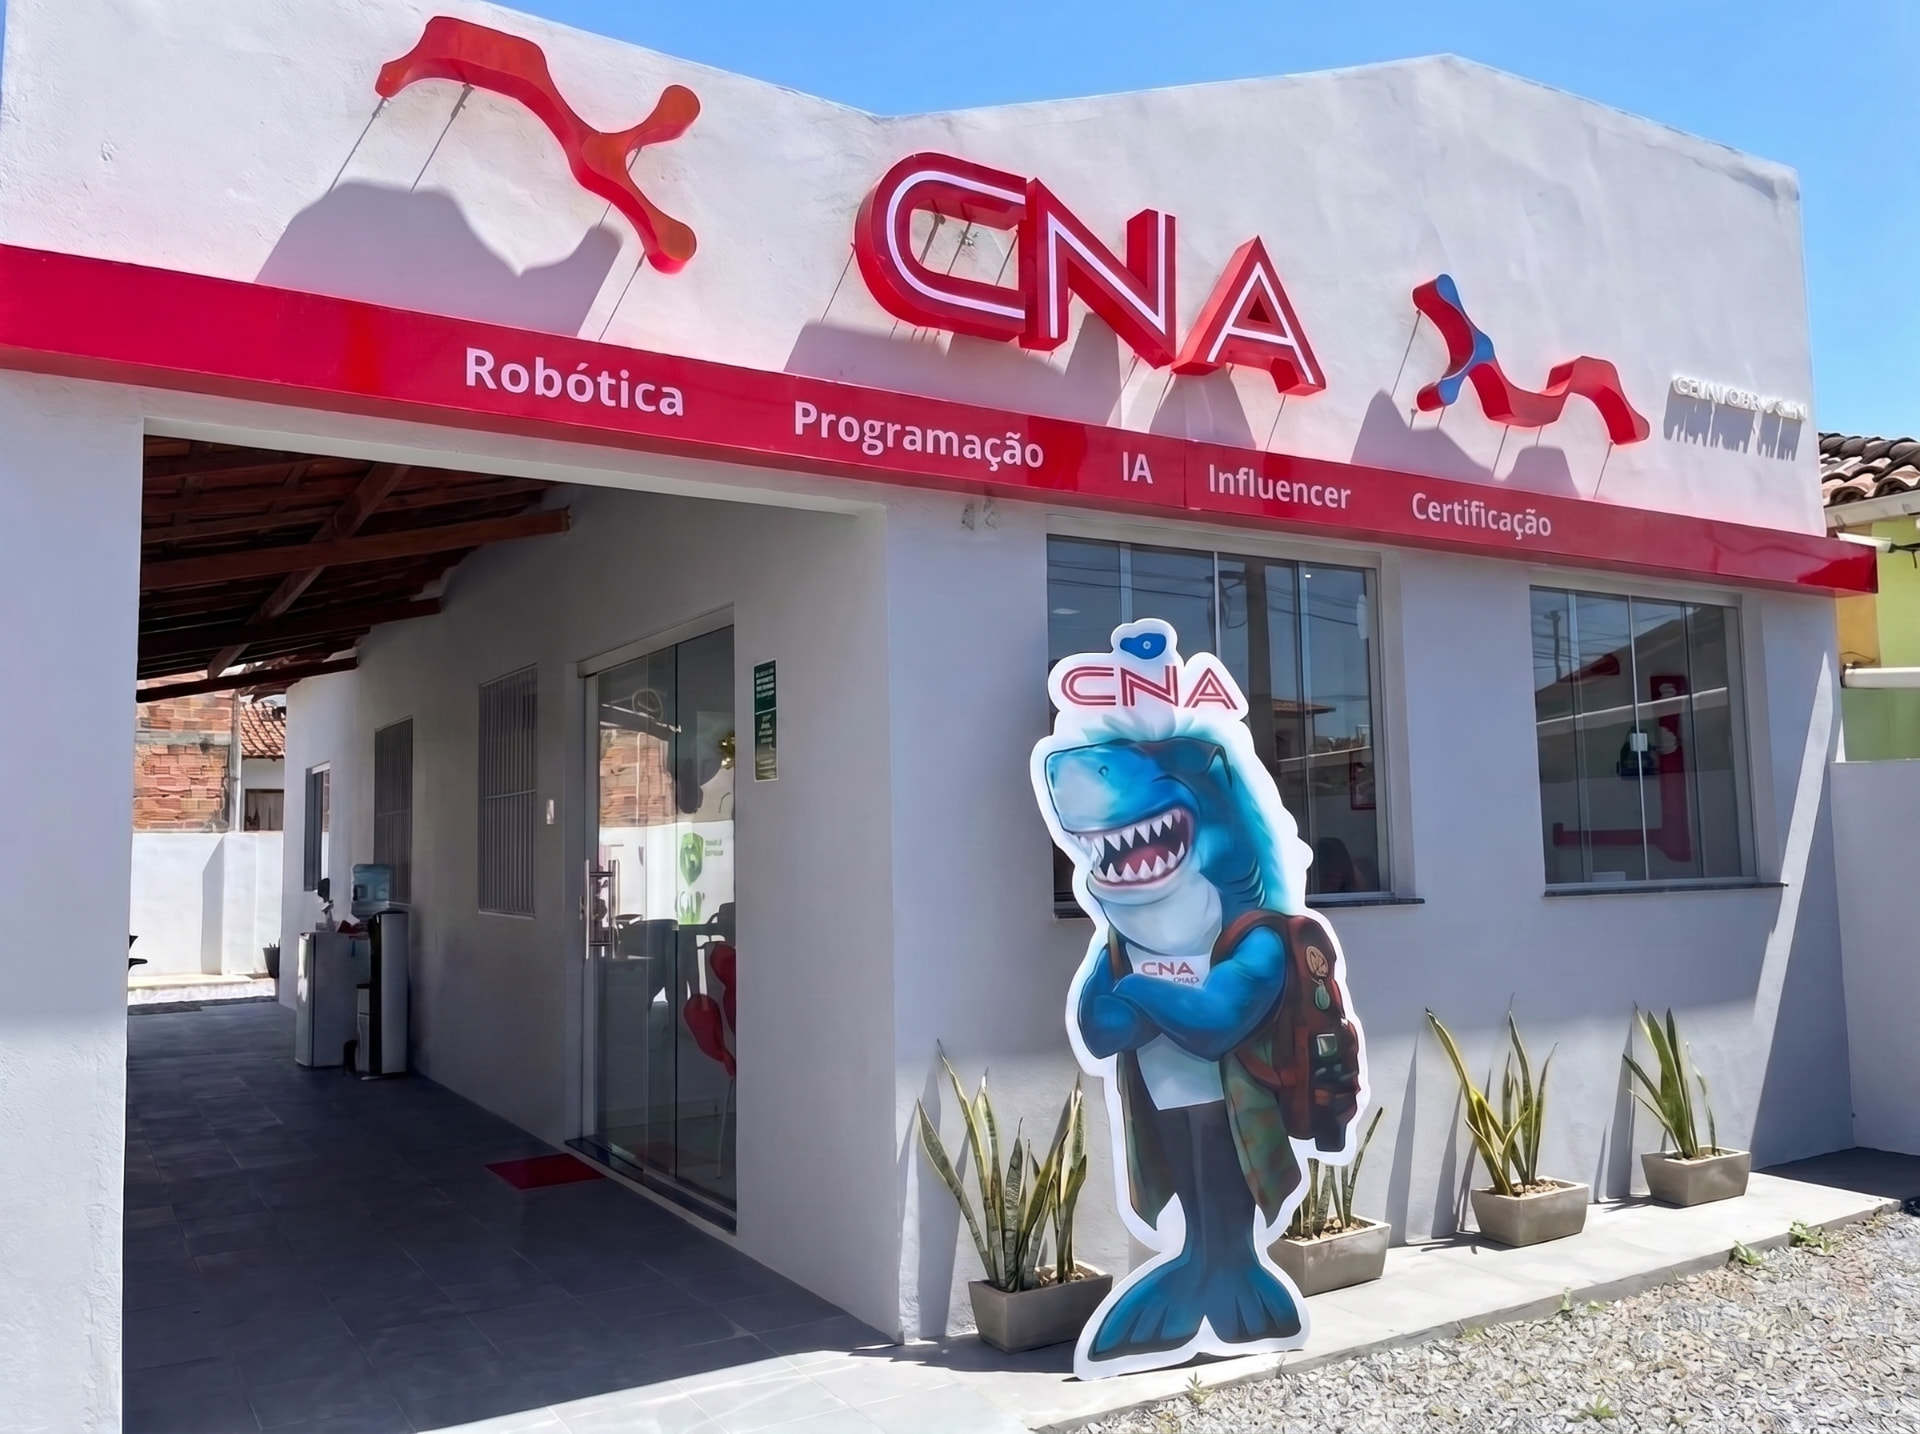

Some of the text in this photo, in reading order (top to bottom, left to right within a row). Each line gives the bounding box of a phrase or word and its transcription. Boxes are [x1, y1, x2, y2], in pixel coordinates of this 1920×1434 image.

[854, 151, 1327, 396] CNA
[464, 346, 1552, 541] Robótica Programação IA Influencer Certificação
[1061, 665, 1238, 710] CNA
[1141, 961, 1195, 976] CNA
